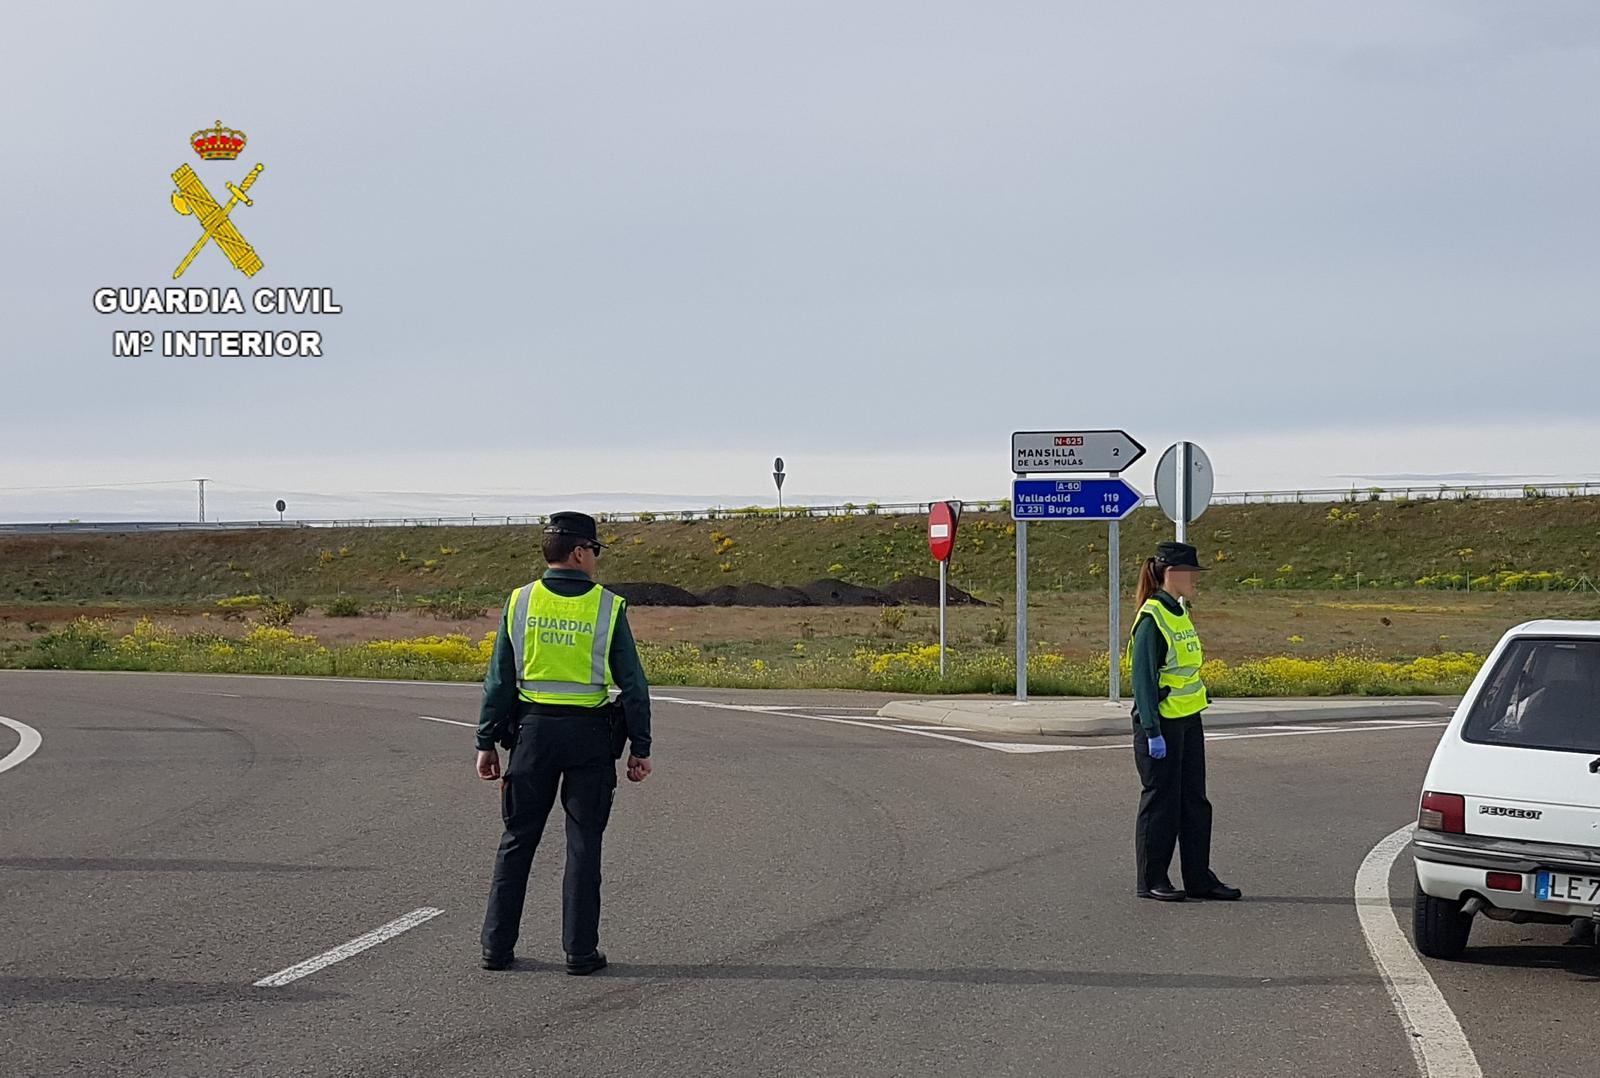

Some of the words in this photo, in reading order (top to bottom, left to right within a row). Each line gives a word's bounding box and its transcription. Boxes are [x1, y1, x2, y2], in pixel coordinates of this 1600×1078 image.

[1055, 437, 1082, 445] N-625
[1018, 449, 1075, 457] MANSILLA
[1112, 448, 1119, 456] 2
[1058, 482, 1079, 490] A-60
[1018, 494, 1071, 503] Valladolid
[1103, 493, 1119, 502] 119
[1048, 505, 1085, 515] Burgos
[1101, 505, 1119, 513] 164
[527, 616, 593, 634] GUARDIA
[540, 632, 576, 646] CIVIL
[1479, 806, 1542, 819] PEUGEOT
